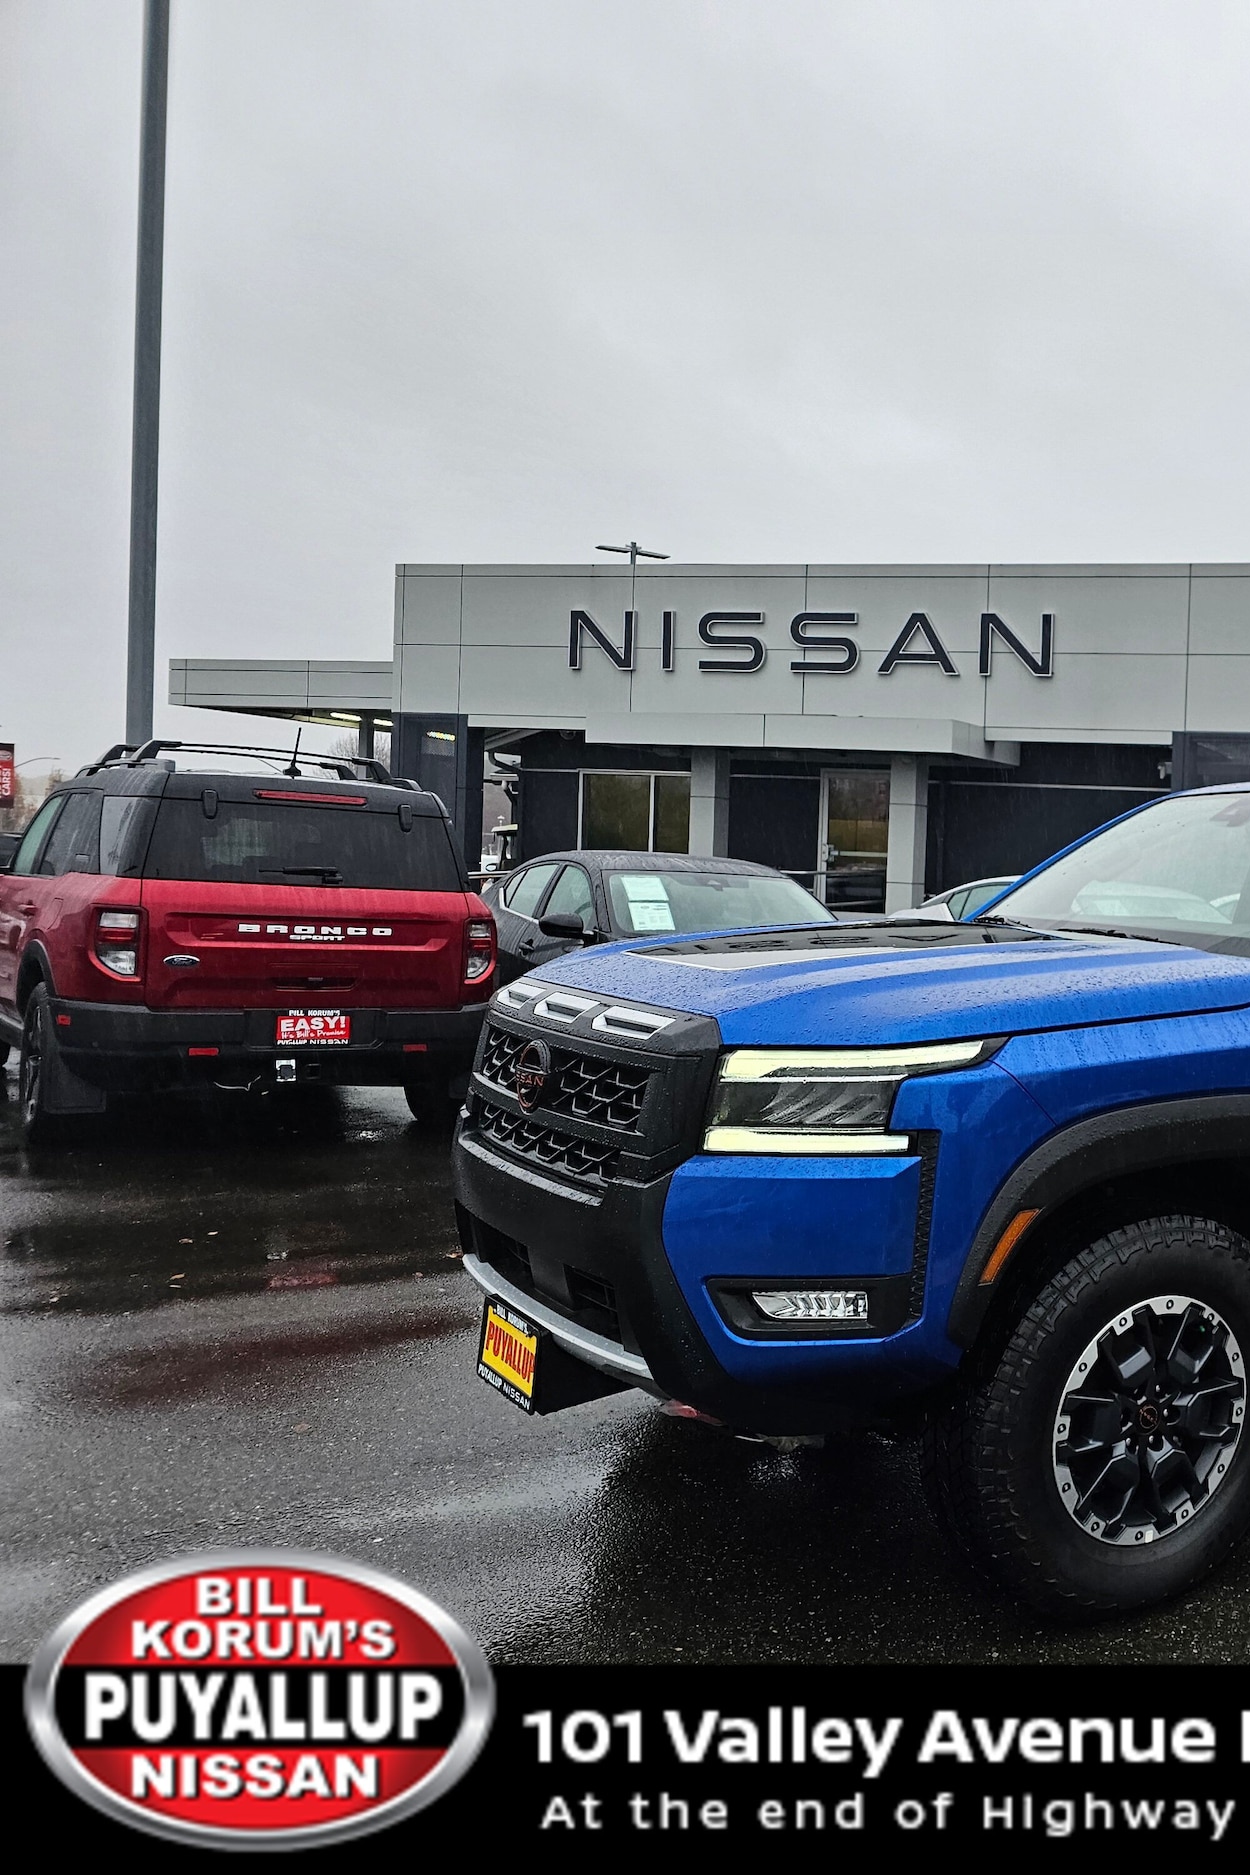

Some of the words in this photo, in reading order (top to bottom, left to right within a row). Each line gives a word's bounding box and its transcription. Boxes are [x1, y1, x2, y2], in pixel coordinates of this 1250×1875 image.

[568, 610, 1054, 677] NISSAN
[238, 923, 392, 936] BRONCO
[280, 1016, 346, 1032] EASY!
[485, 1320, 535, 1384] PUYALLUP
[478, 1363, 502, 1389] PUYALLUP
[503, 1382, 531, 1411] NISSAN
